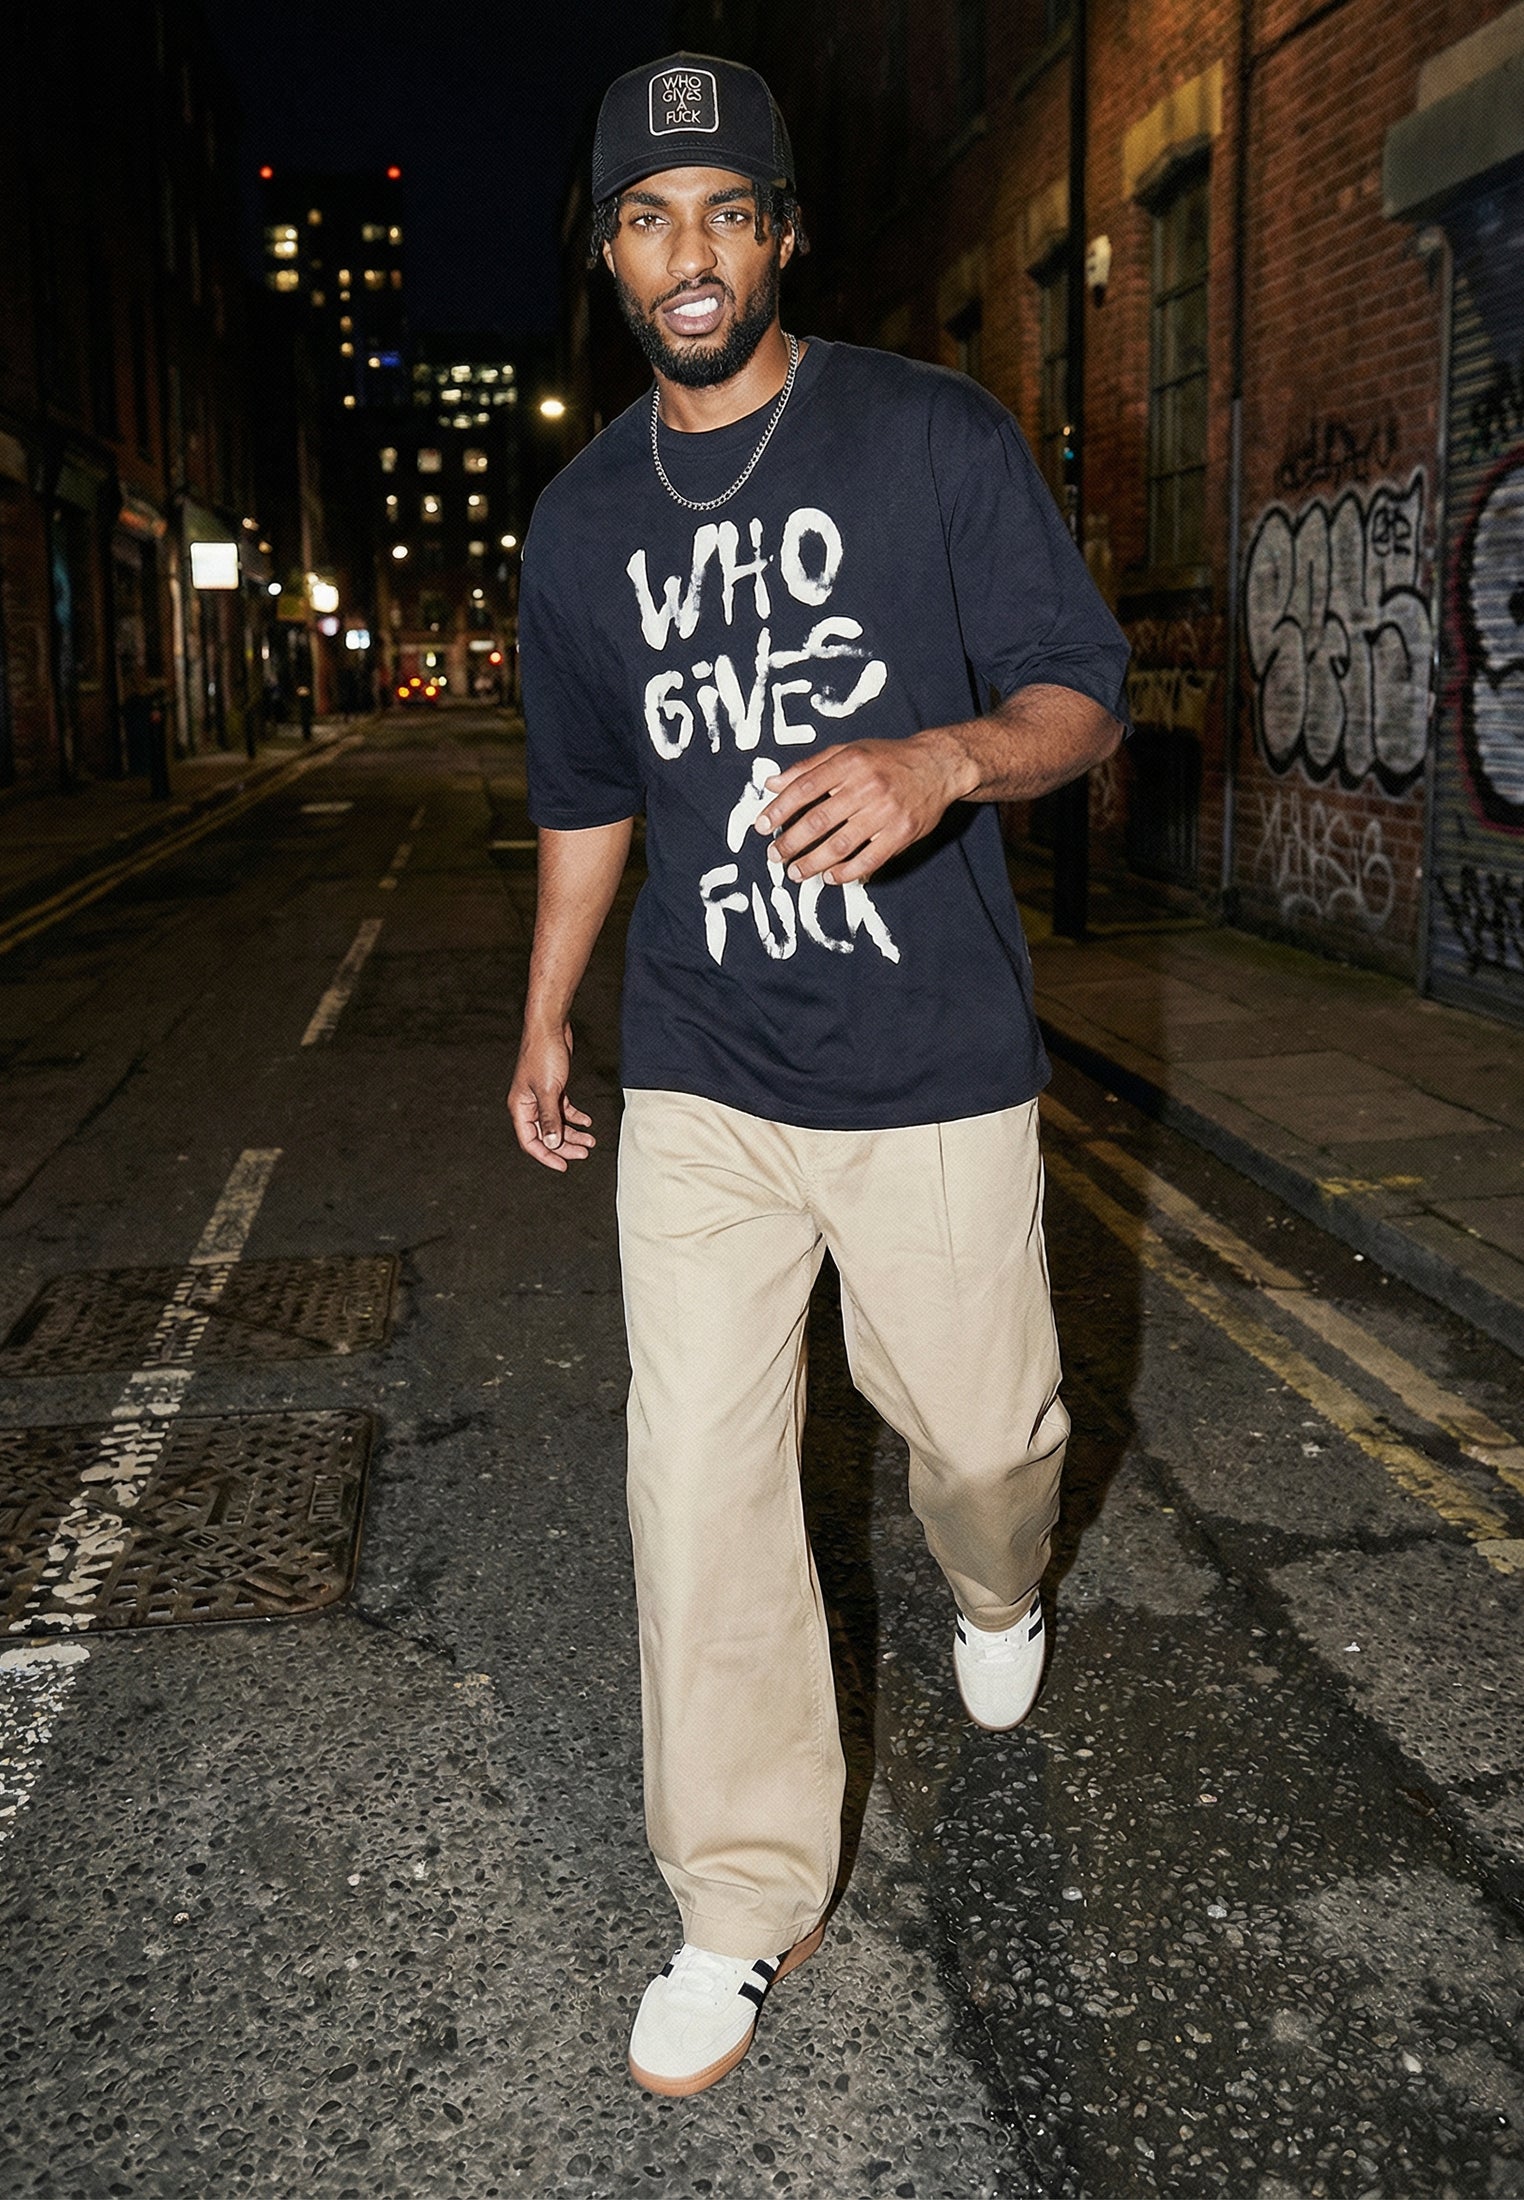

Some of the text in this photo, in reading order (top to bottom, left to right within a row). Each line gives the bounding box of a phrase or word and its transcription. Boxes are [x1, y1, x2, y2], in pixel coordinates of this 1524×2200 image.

[662, 74, 702, 90] WHO
[676, 101, 688, 112] A
[666, 109, 701, 125] FUCK
[626, 507, 844, 651] WHO
